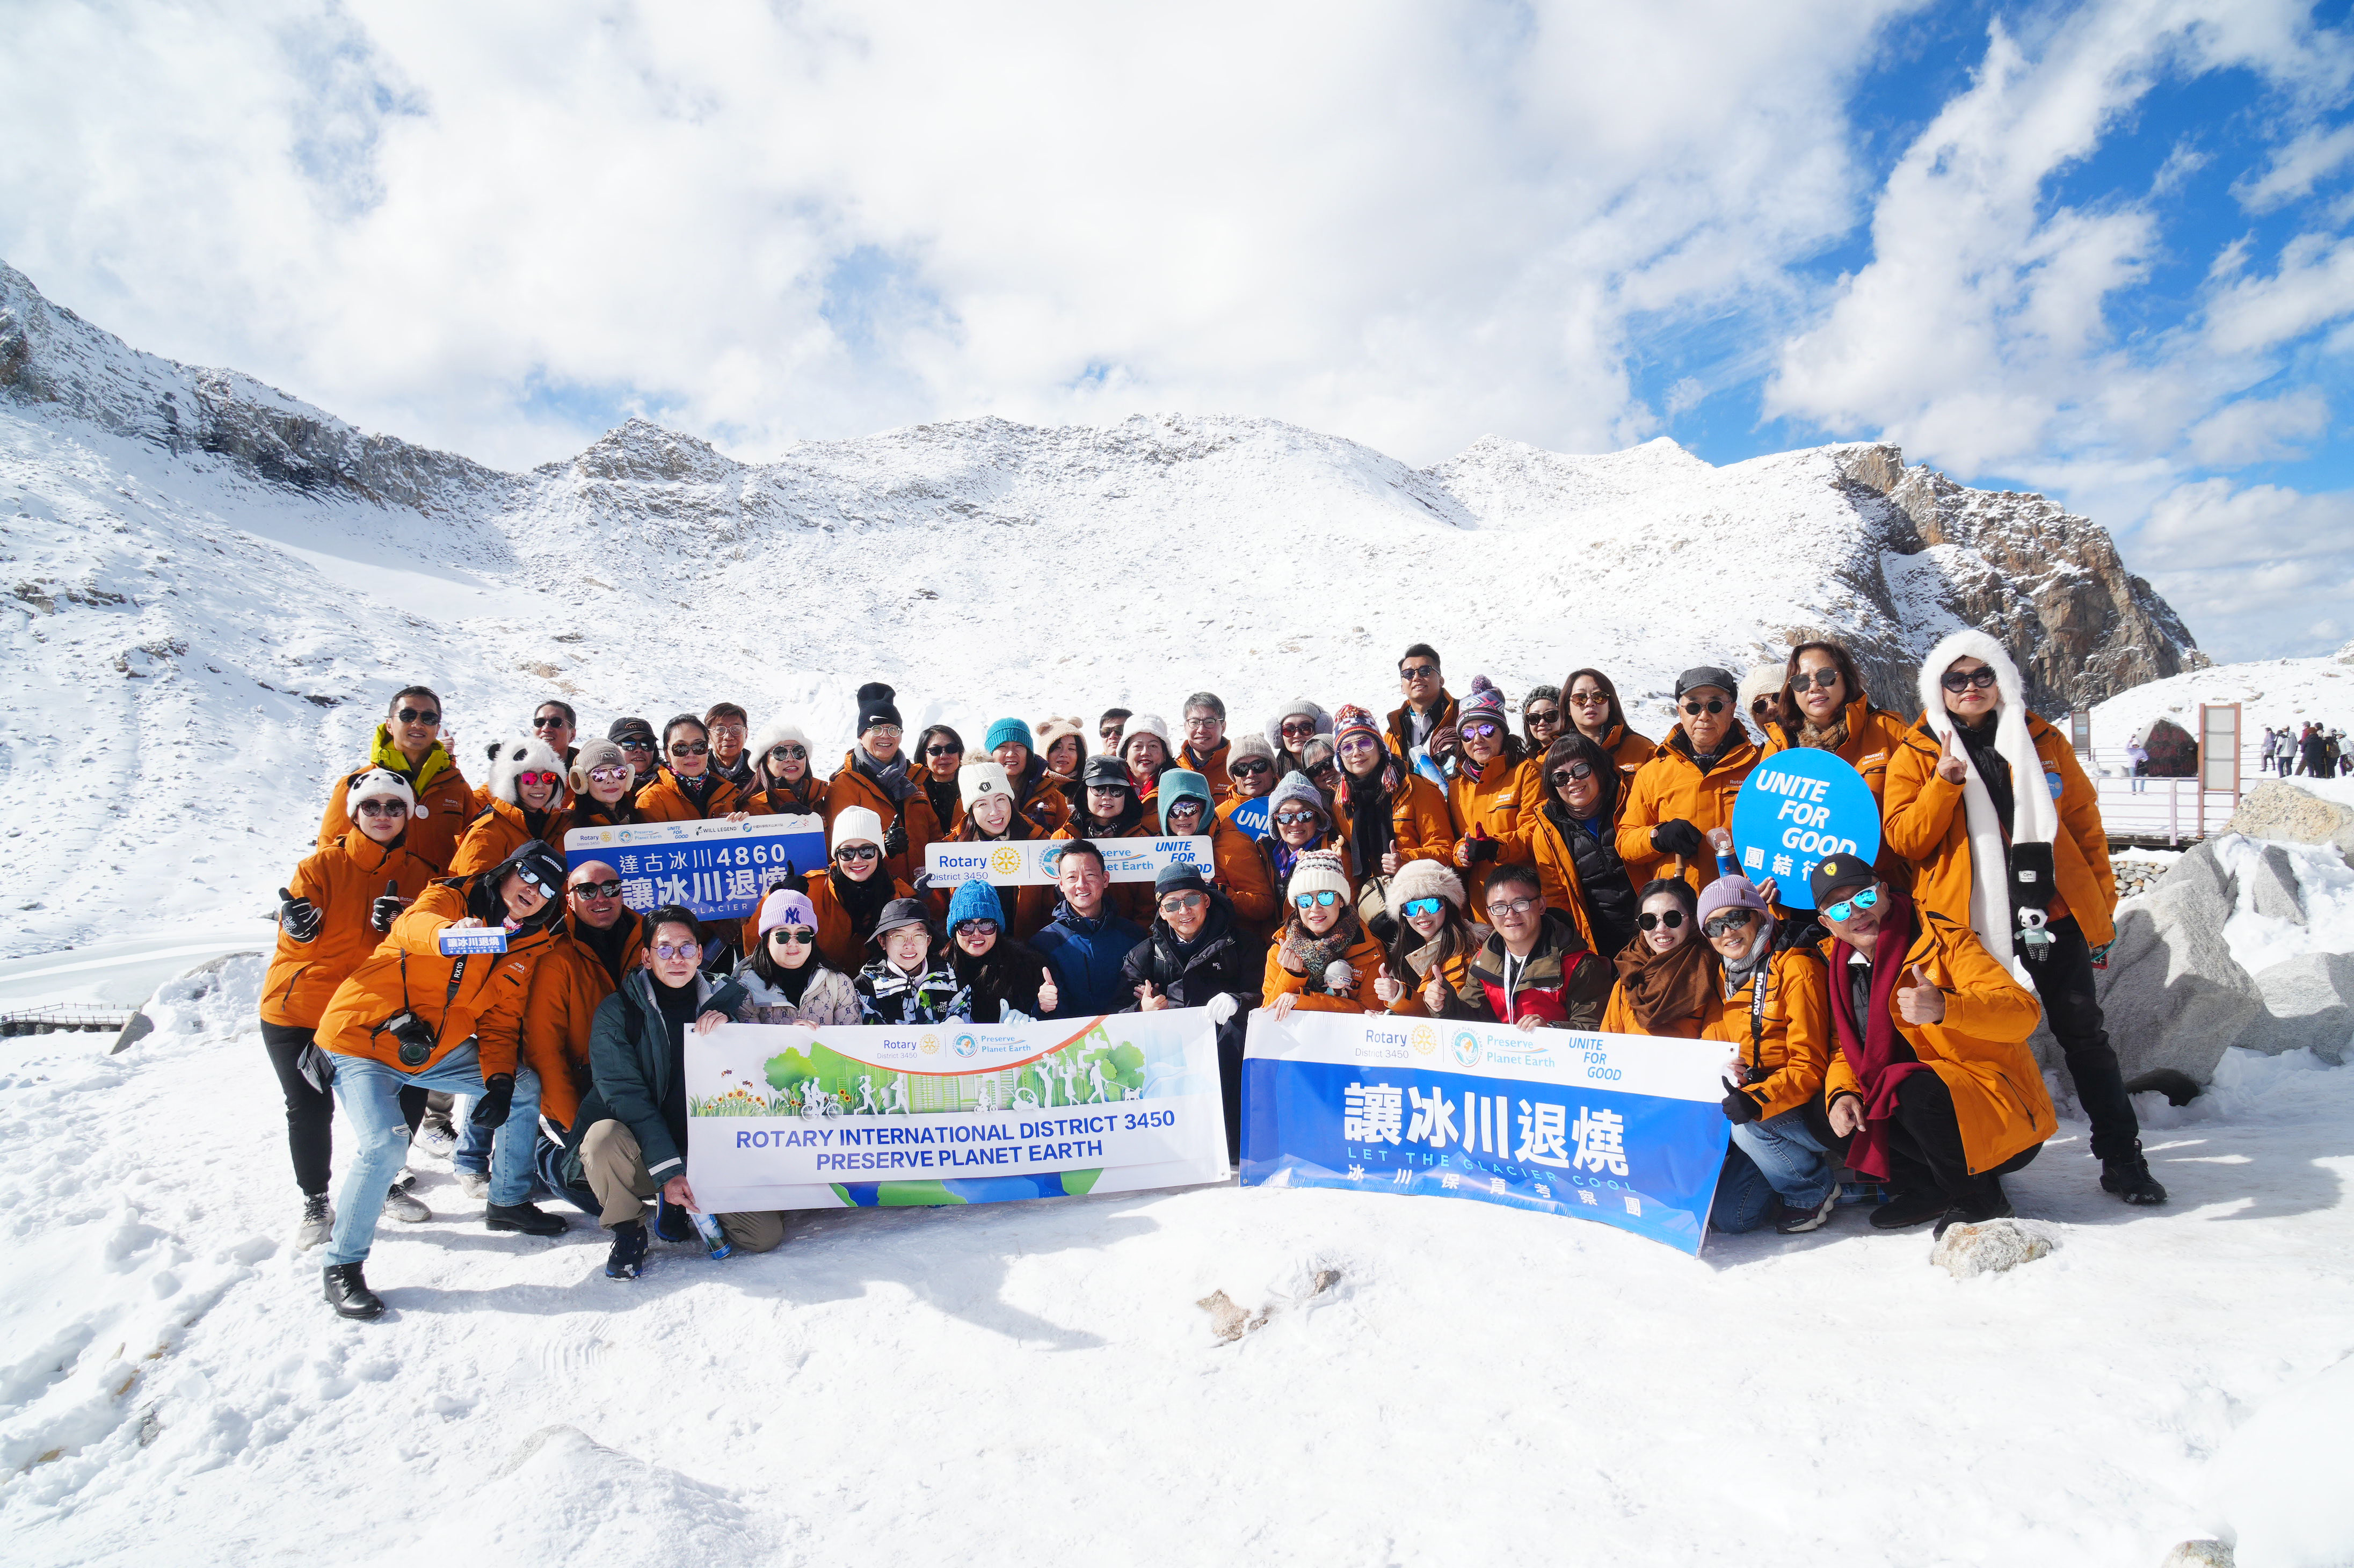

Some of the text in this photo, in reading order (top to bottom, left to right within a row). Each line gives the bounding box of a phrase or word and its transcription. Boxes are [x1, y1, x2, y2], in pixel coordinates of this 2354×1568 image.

[1756, 769, 1830, 802] UNITE
[1237, 809, 1269, 831] UNI
[1777, 800, 1830, 829] FOR
[1156, 841, 1191, 852] UNITE
[1782, 827, 1857, 856] GOOD
[940, 855, 987, 869] Rotary
[1038, 845, 1051, 868] PRESERVE
[1171, 853, 1195, 863] FOR
[1122, 861, 1154, 870] Earth
[929, 871, 988, 881] District 3450
[692, 903, 747, 914] GLACIER
[785, 906, 801, 924] NY
[447, 937, 500, 948] 讓冰川退燒
[454, 962, 463, 978] RX10
[1753, 972, 1764, 1015] OLYMPUS
[1365, 1029, 1407, 1047] Rotary
[1462, 1026, 1478, 1036] PLANET
[884, 1040, 917, 1051] Rotary
[1487, 1035, 1534, 1049] Preserve
[1568, 1037, 1604, 1051] UNITE
[1355, 1047, 1410, 1059] District 3450
[1487, 1052, 1555, 1068] Planet Earth
[1583, 1051, 1607, 1065] FOR
[1587, 1066, 1622, 1081] GOOD
[737, 1109, 1175, 1149] ROTARY INTERNATIONAL DISTRICT 3450
[1343, 1081, 1630, 1177] 讓冰川退燒
[817, 1139, 1102, 1171] PRESERVE PLANET EARTH
[1347, 1146, 1637, 1194] LET THE GLACIER COOL
[1347, 1163, 1642, 1217] 冰川保育考察團
